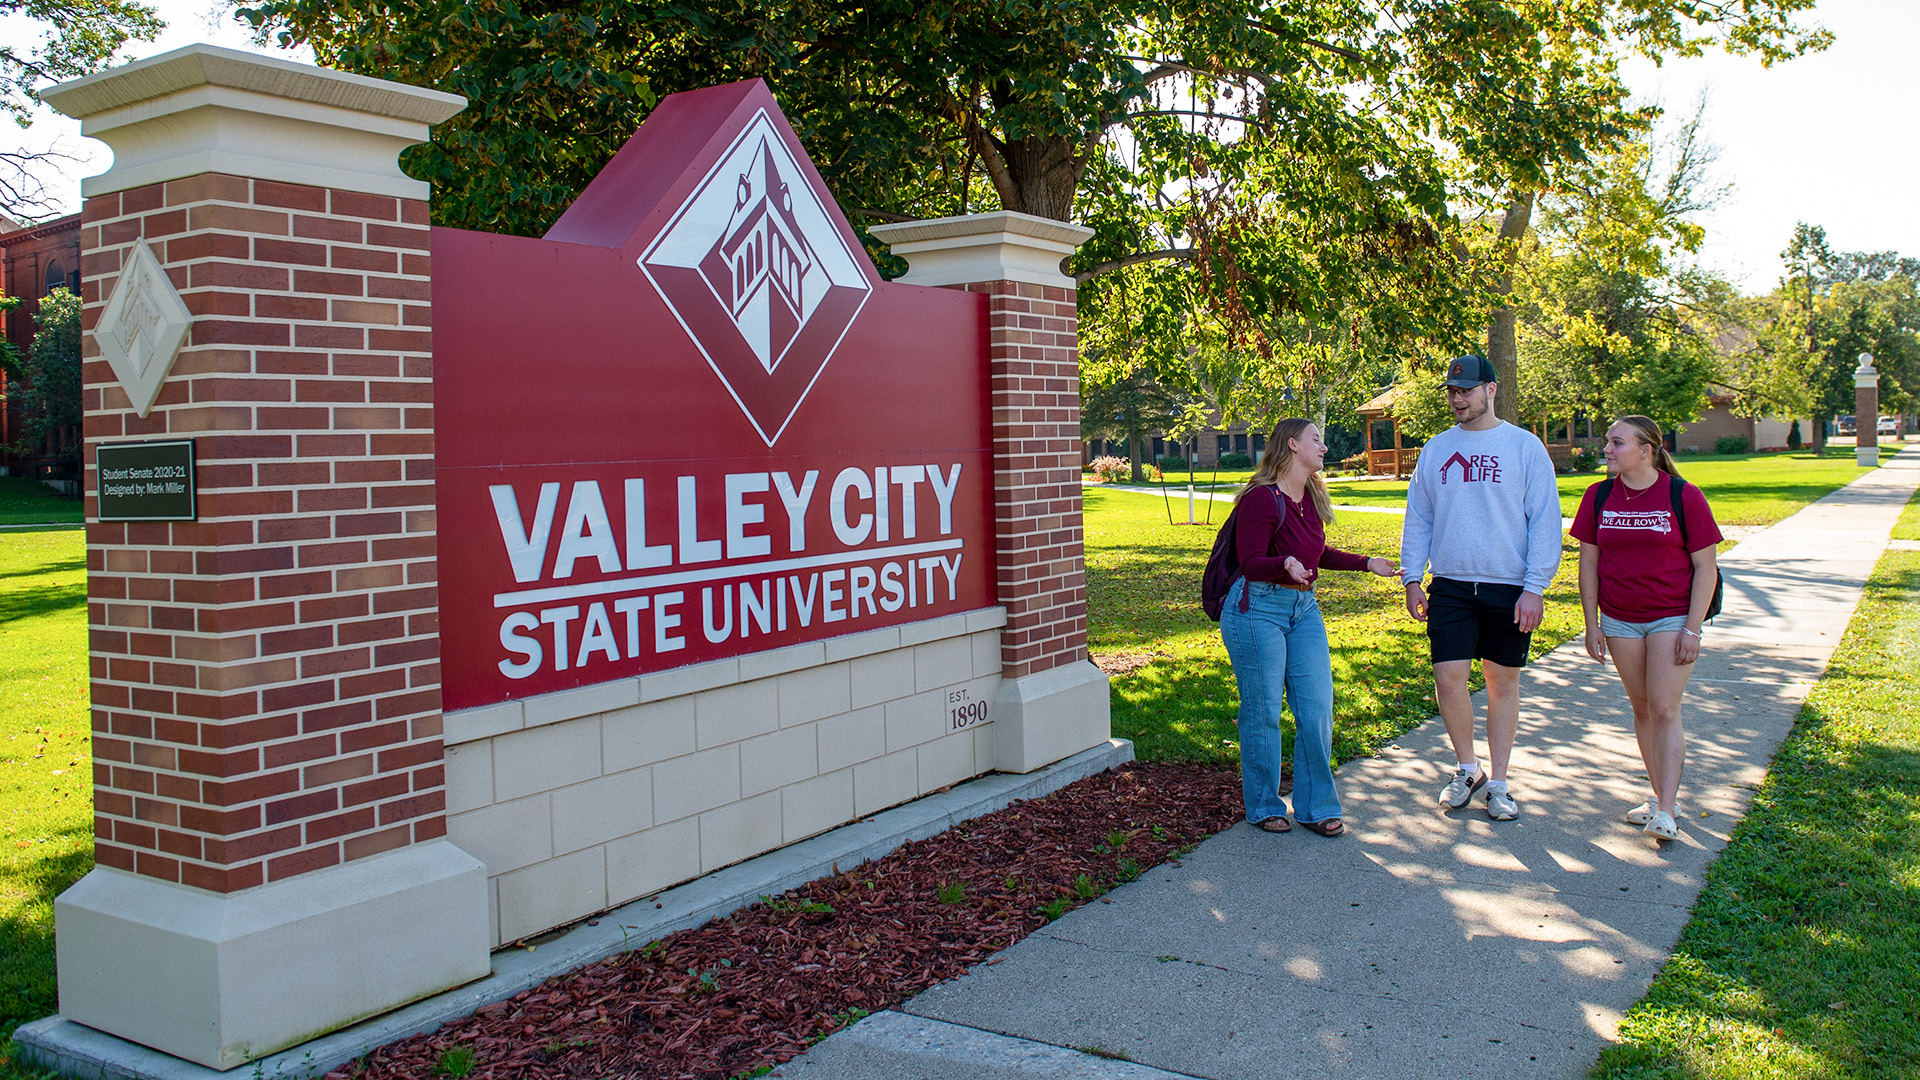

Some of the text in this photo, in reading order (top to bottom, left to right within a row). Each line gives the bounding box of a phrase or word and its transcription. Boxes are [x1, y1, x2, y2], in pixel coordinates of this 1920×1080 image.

[1470, 455, 1499, 468] RES
[103, 466, 186, 480] Student Senate 2020-21
[1470, 468, 1502, 483] LIFE
[104, 482, 185, 497] Designed by: Mark Miller
[489, 463, 963, 583] VALLEY CITY
[1602, 517, 1657, 526] WE ALL ROW
[498, 553, 963, 679] STATE UNIVERSITY
[949, 689, 970, 703] EST.
[951, 700, 987, 730] 1890
